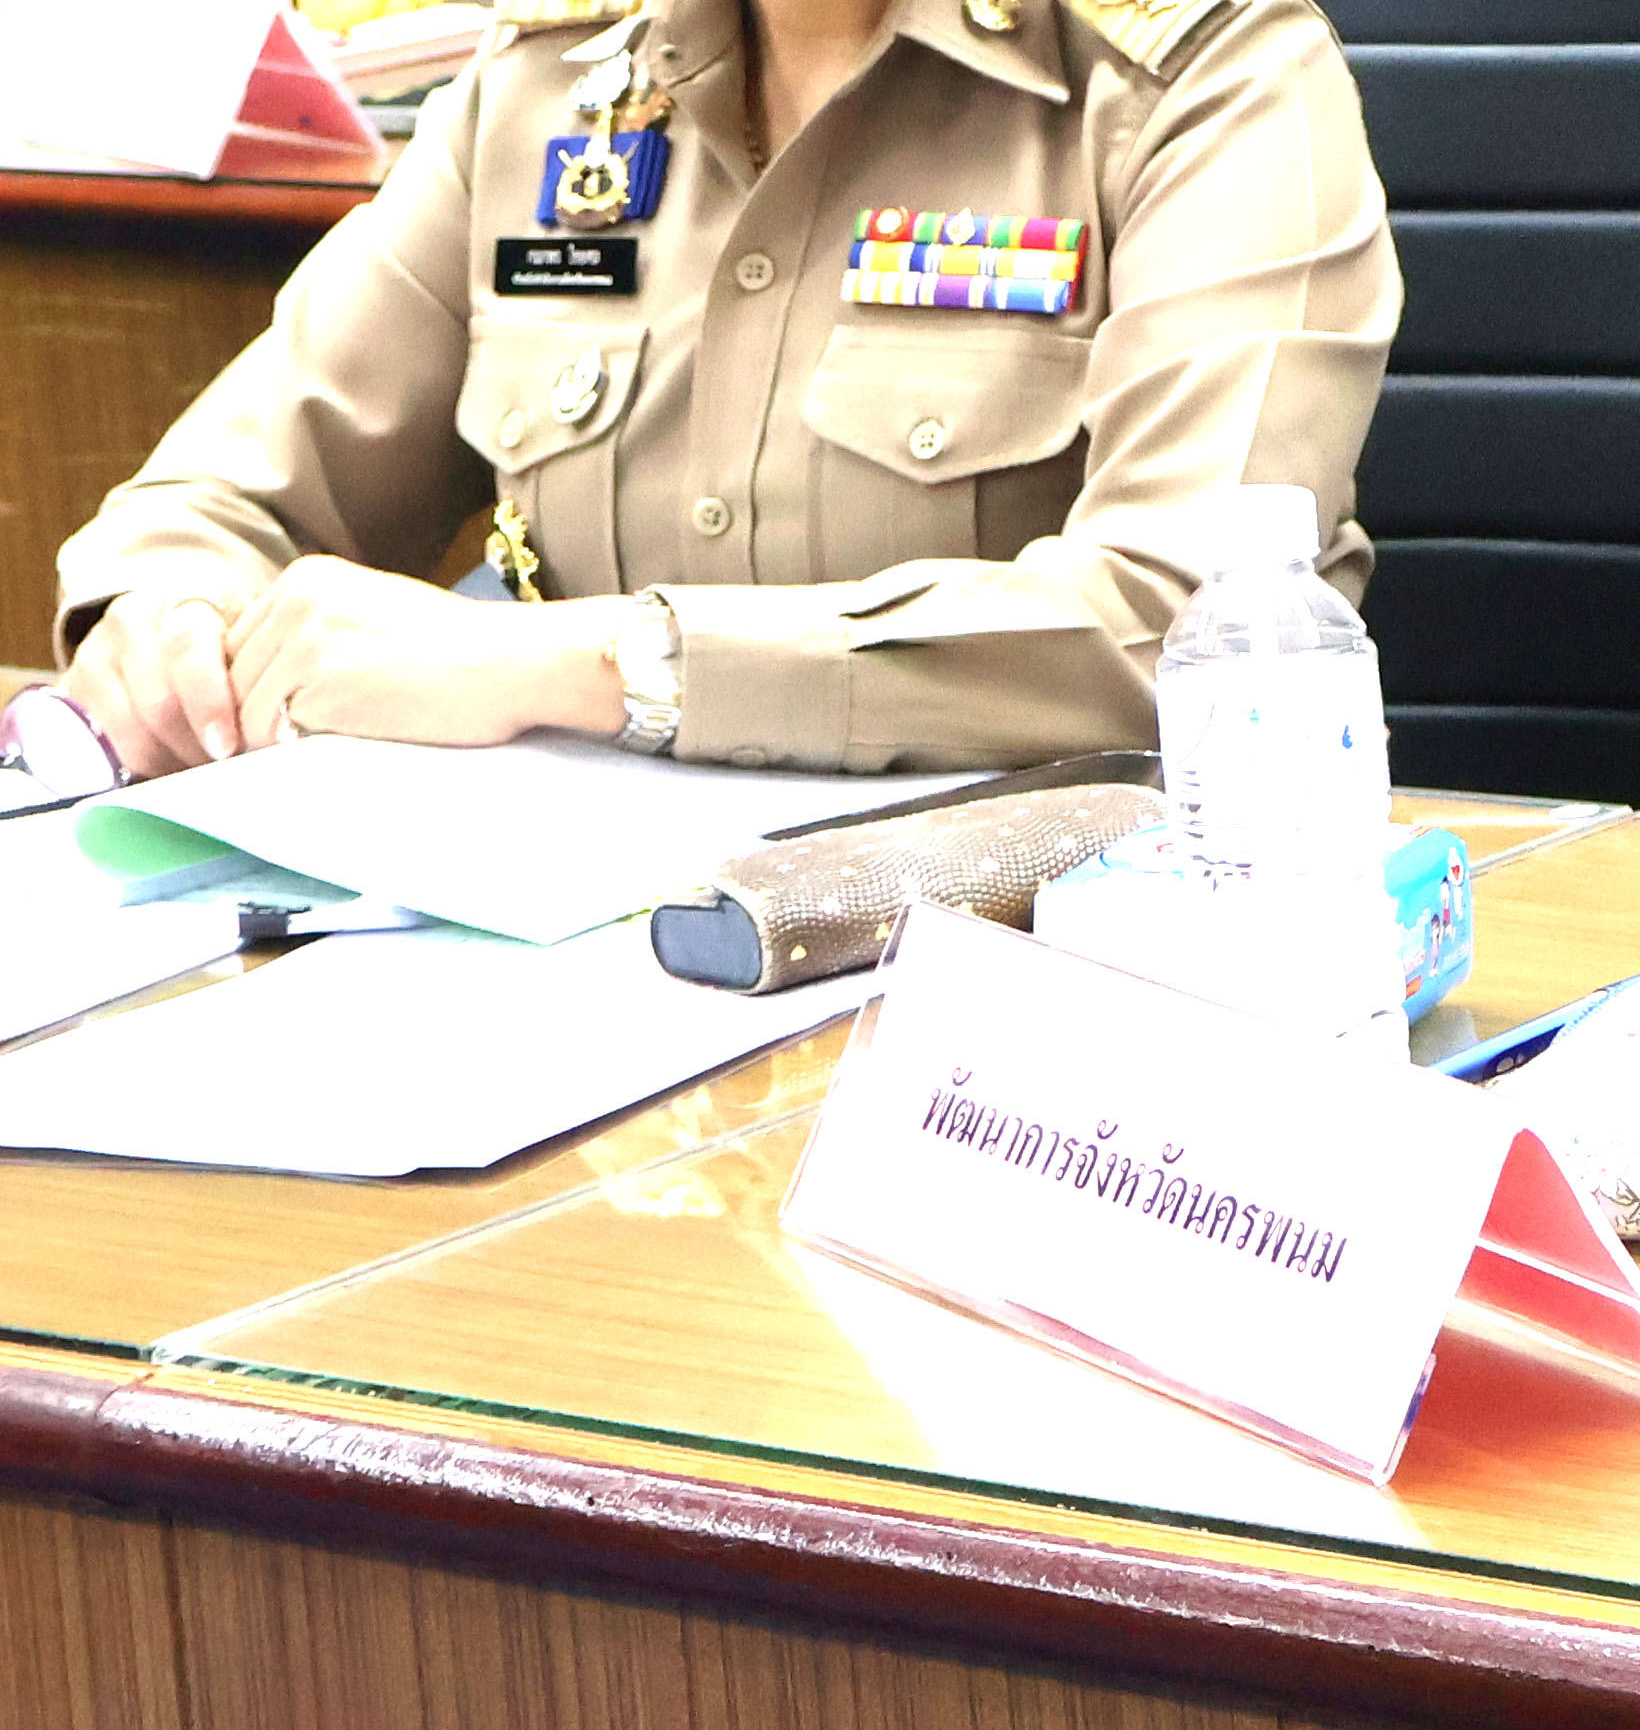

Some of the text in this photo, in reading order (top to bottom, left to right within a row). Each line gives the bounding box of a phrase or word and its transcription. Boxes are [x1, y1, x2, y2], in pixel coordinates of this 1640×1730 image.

[920, 1067, 1347, 1282] พัฒนาการจังหวัดนครพนม
